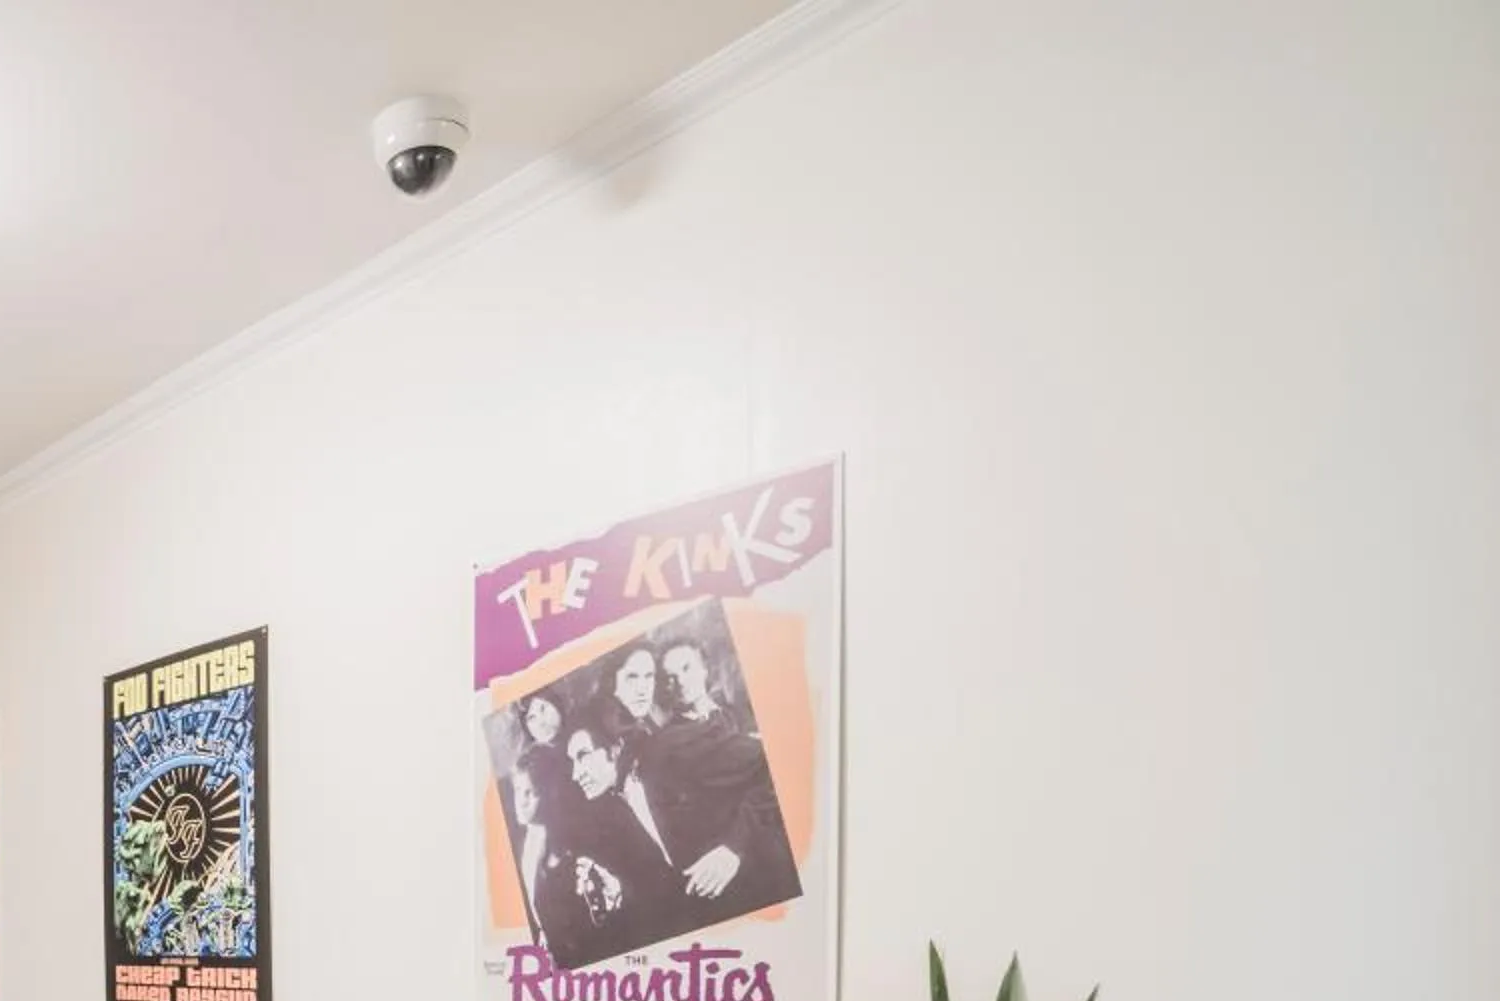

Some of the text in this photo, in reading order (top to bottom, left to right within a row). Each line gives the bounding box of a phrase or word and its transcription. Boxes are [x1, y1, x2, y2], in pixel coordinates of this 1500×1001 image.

[497, 486, 817, 649] THE KINKS
[112, 639, 256, 720] FOO FIGHTERS
[625, 955, 648, 966] THE
